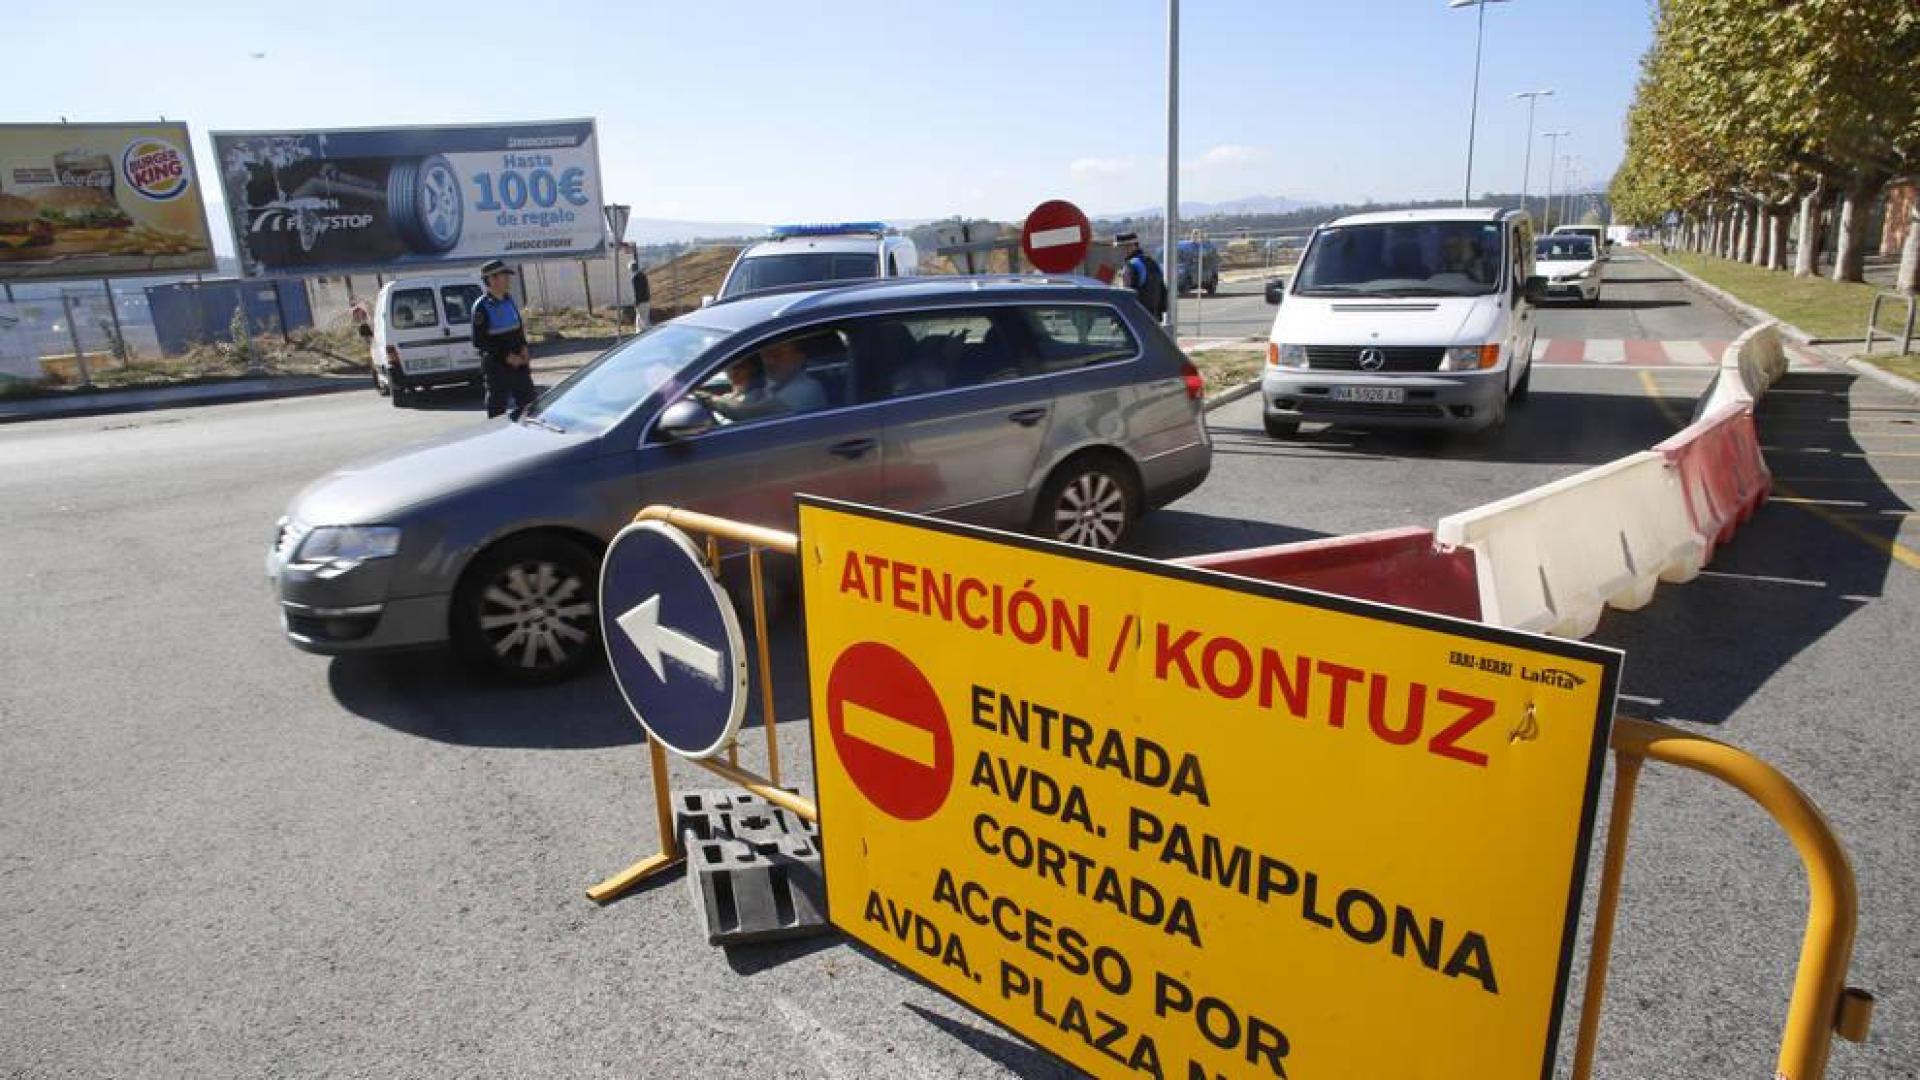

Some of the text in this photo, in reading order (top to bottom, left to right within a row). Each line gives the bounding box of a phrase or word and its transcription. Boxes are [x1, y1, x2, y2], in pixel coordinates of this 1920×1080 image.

[129, 150, 179, 174] BURGER
[135, 160, 183, 188] KING
[503, 153, 553, 168] Hasta
[472, 166, 590, 211] 100€
[496, 207, 575, 228] de regalo
[840, 550, 1496, 768] ATENCIÓN / KONTUZ
[1448, 650, 1513, 677] ERRI-BERRI
[1520, 666, 1577, 690] Lakita
[970, 685, 1211, 808] ENTRADA
[970, 751, 1500, 996] AVDA. PAMPLONA
[973, 814, 1203, 949] CORTADA
[864, 890, 1165, 1080] AVDA. PLAZA
[932, 868, 1291, 1080] ACCESO POR
